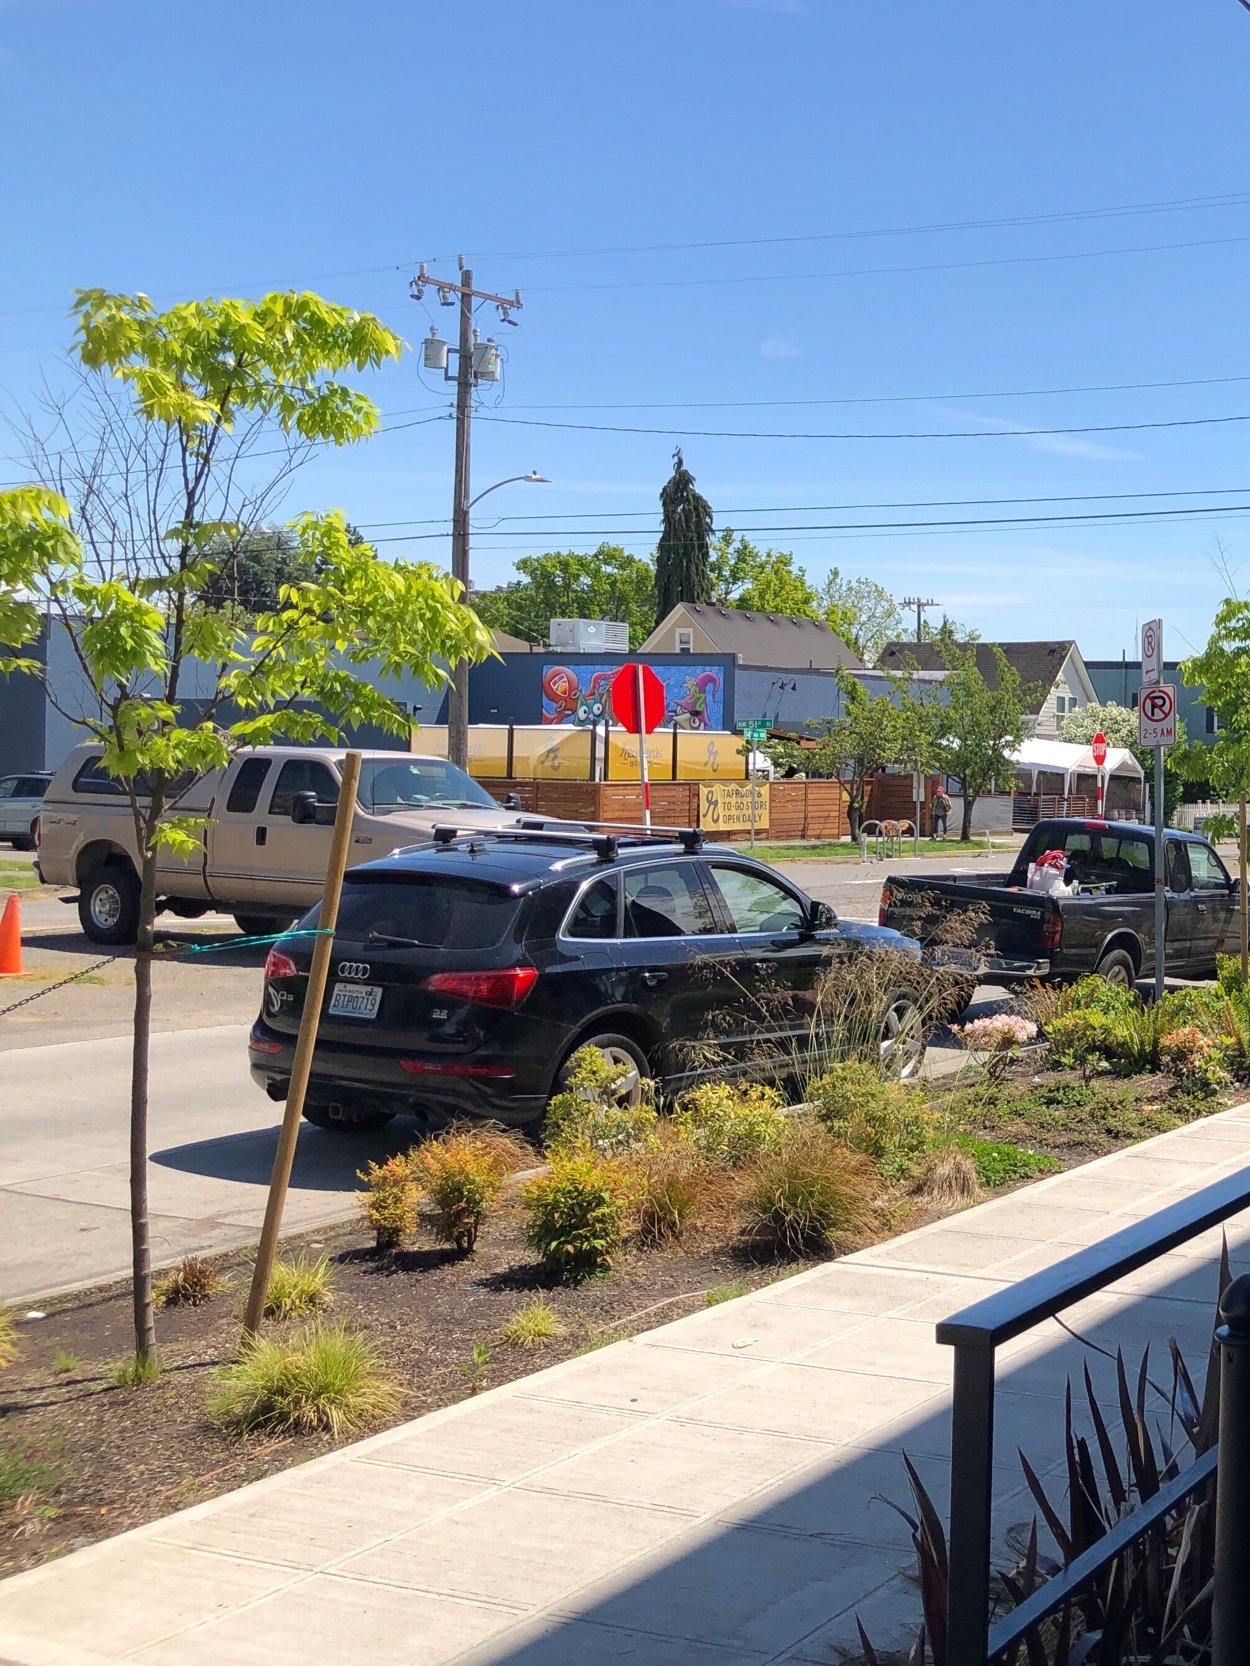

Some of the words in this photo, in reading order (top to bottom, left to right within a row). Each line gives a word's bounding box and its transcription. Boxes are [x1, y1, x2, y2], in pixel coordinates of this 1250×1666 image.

[1142, 728, 1158, 739] 2-5
[1160, 727, 1173, 738] AM
[1093, 743, 1106, 756] STOP
[757, 789, 762, 798] &
[722, 801, 745, 811] TO-GO
[722, 813, 741, 824] OPEN
[742, 813, 762, 823] DALY
[1012, 907, 1041, 916] TACOMA
[333, 993, 377, 1012] BTP0719
